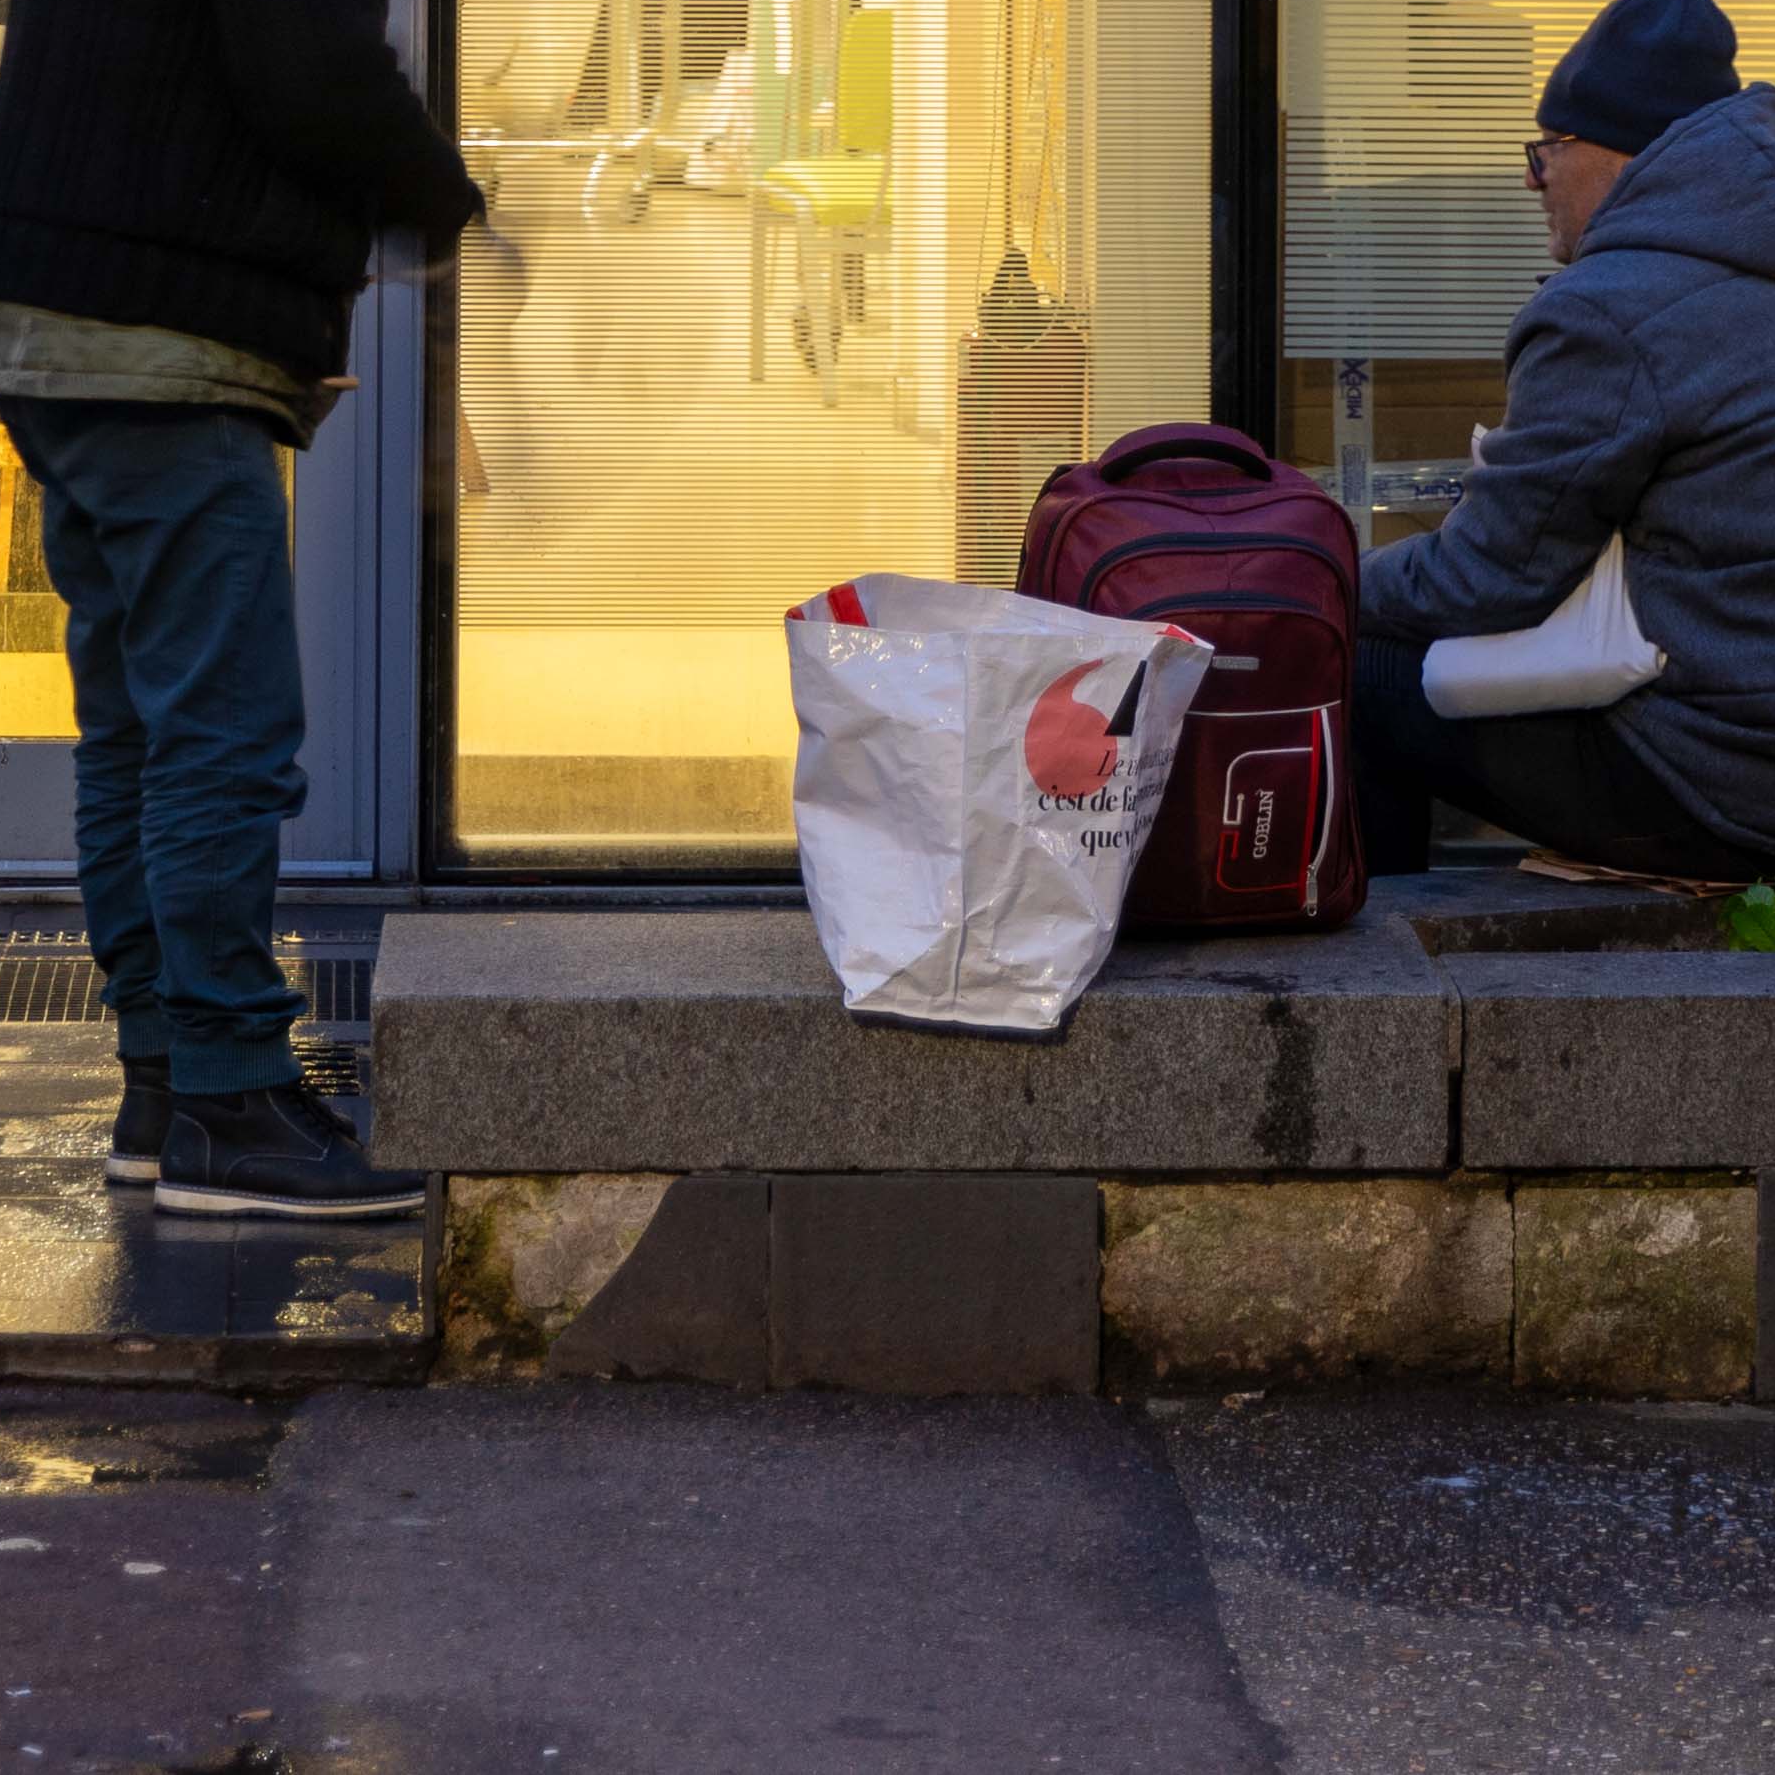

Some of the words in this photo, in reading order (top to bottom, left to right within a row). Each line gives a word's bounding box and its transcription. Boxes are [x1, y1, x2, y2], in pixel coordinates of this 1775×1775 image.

[1038, 784, 1085, 812] c'est
[1090, 786, 1118, 813] de
[1252, 790, 1274, 860] GOBLIN
[1080, 829, 1122, 857] que
